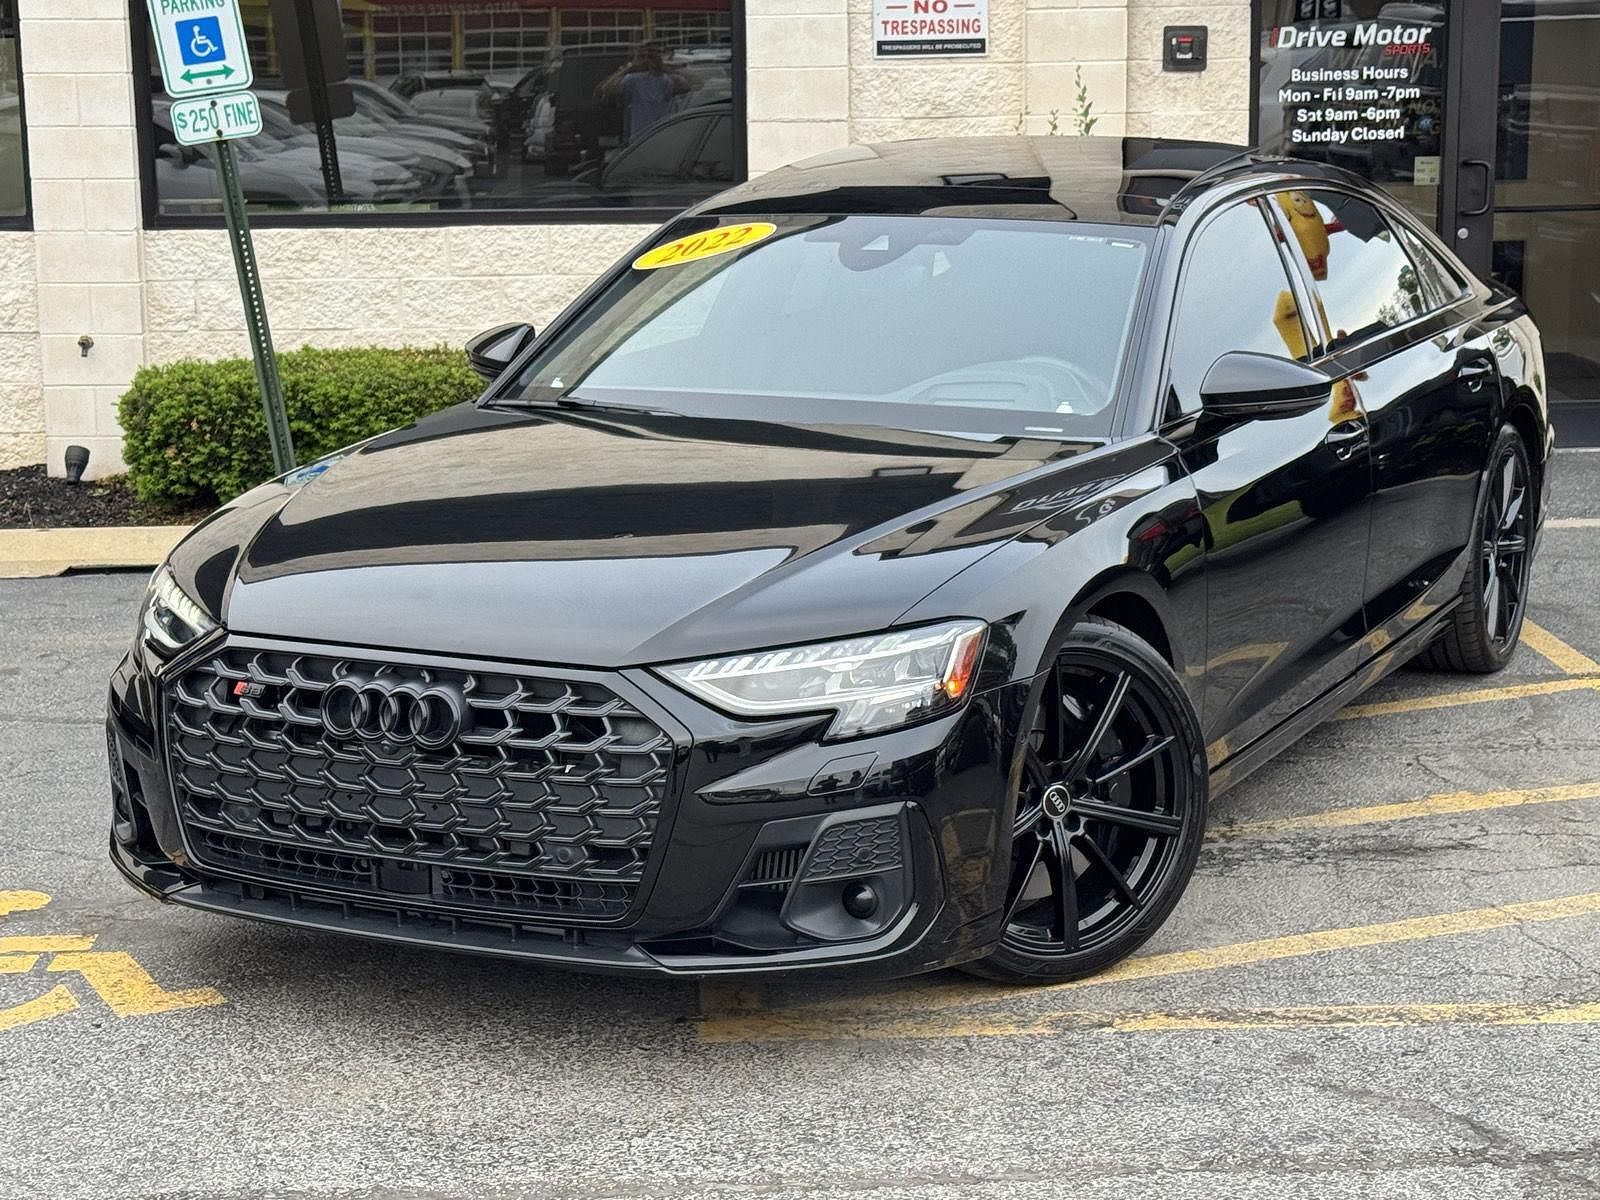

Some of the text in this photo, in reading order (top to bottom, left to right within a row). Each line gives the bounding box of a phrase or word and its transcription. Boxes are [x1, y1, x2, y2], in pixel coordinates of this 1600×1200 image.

[913, 0, 948, 14] NO
[881, 19, 981, 36] TRESPASSING
[1353, 23, 1432, 46] Motor
[1385, 43, 1431, 55] SPORTS
[1291, 66, 1409, 82] Business Hours
[1278, 89, 1311, 102] Mon
[1345, 87, 1379, 101] 9am
[223, 101, 257, 128] FINE
[1297, 108, 1323, 122] Sat
[1325, 107, 1358, 121] 9am
[1292, 125, 1405, 144] Sunday Closed
[656, 226, 752, 263] 2022
